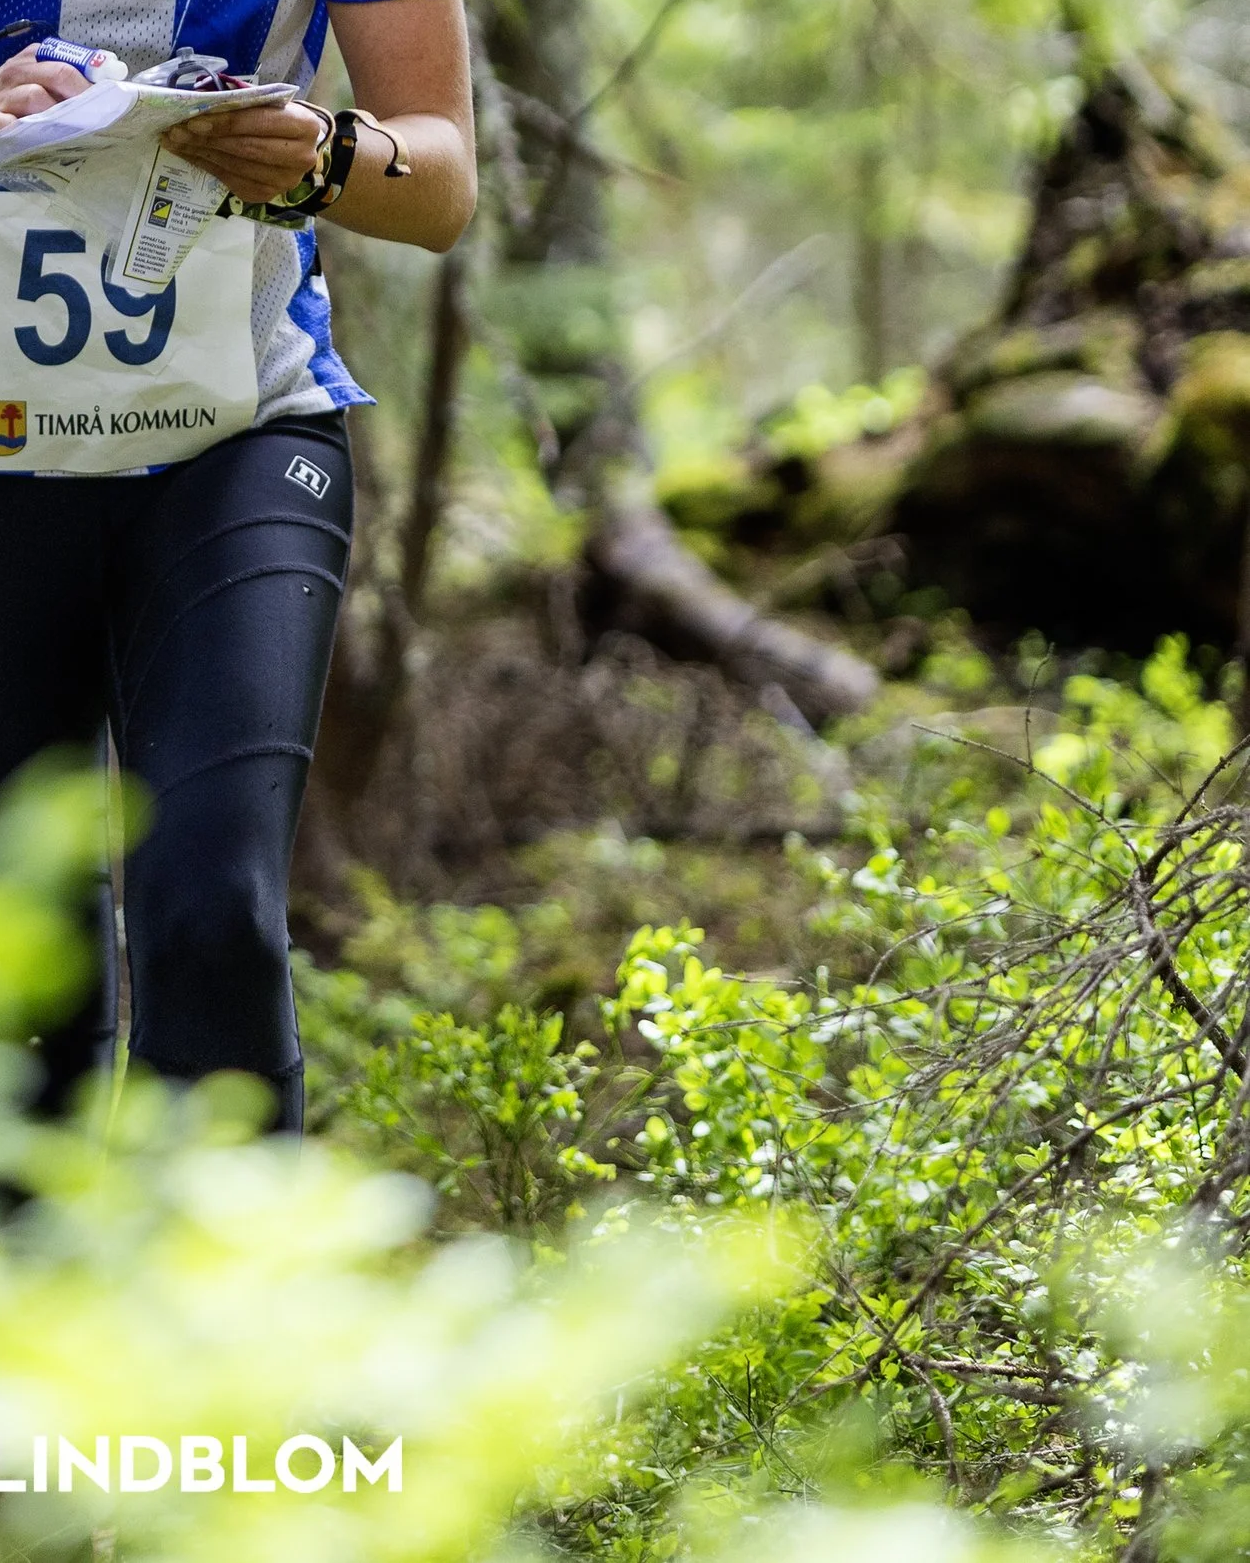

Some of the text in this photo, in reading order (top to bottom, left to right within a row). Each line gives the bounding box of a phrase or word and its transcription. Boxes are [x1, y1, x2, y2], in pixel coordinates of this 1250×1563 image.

[14, 229, 177, 366] 59
[34, 405, 217, 436] TIMRÅ KOMMUN
